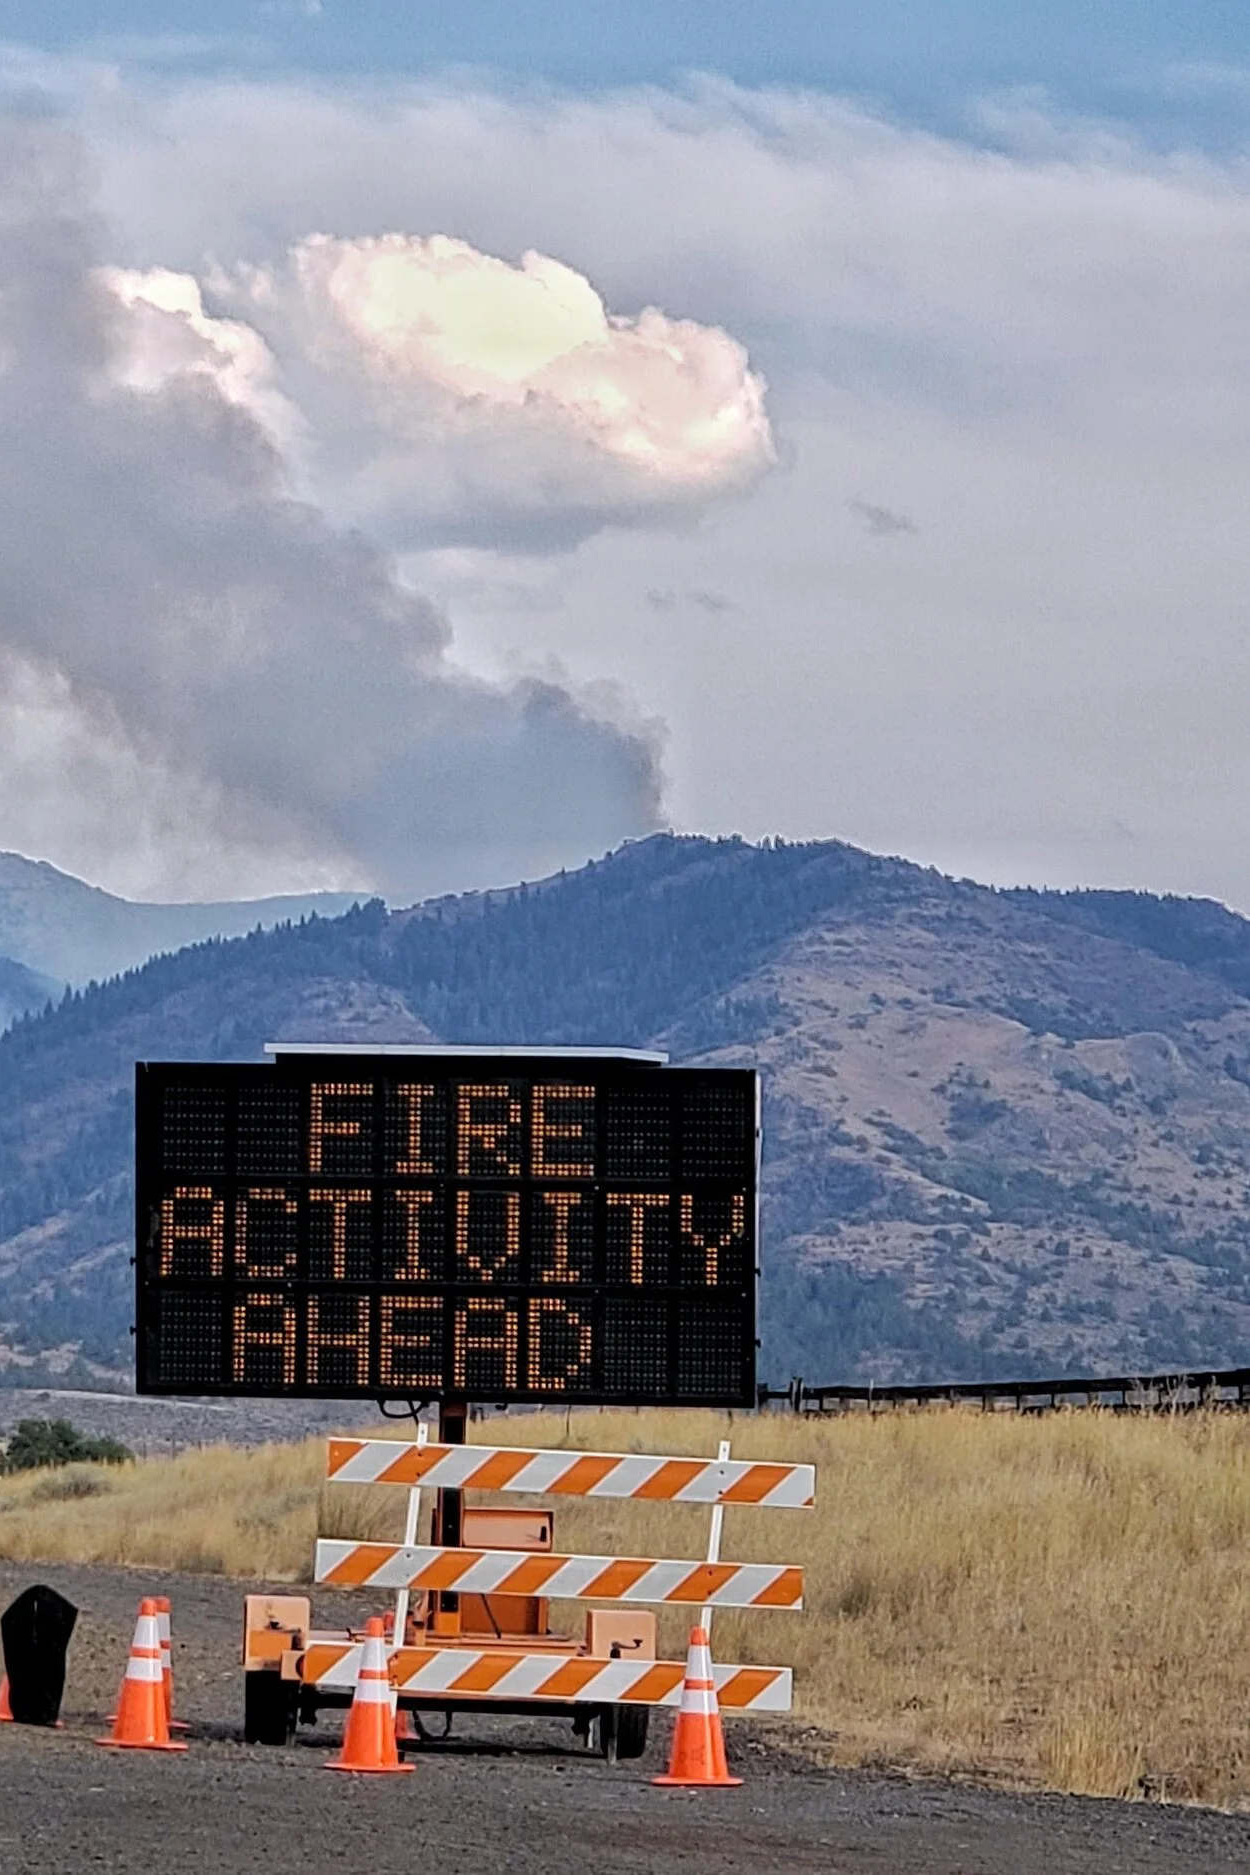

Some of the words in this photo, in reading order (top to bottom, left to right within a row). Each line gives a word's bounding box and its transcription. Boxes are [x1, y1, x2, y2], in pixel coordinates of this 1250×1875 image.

[308, 1082, 596, 1178] FIRE
[159, 1186, 745, 1287] ACTIVITY
[231, 1293, 593, 1391] AHEAD
